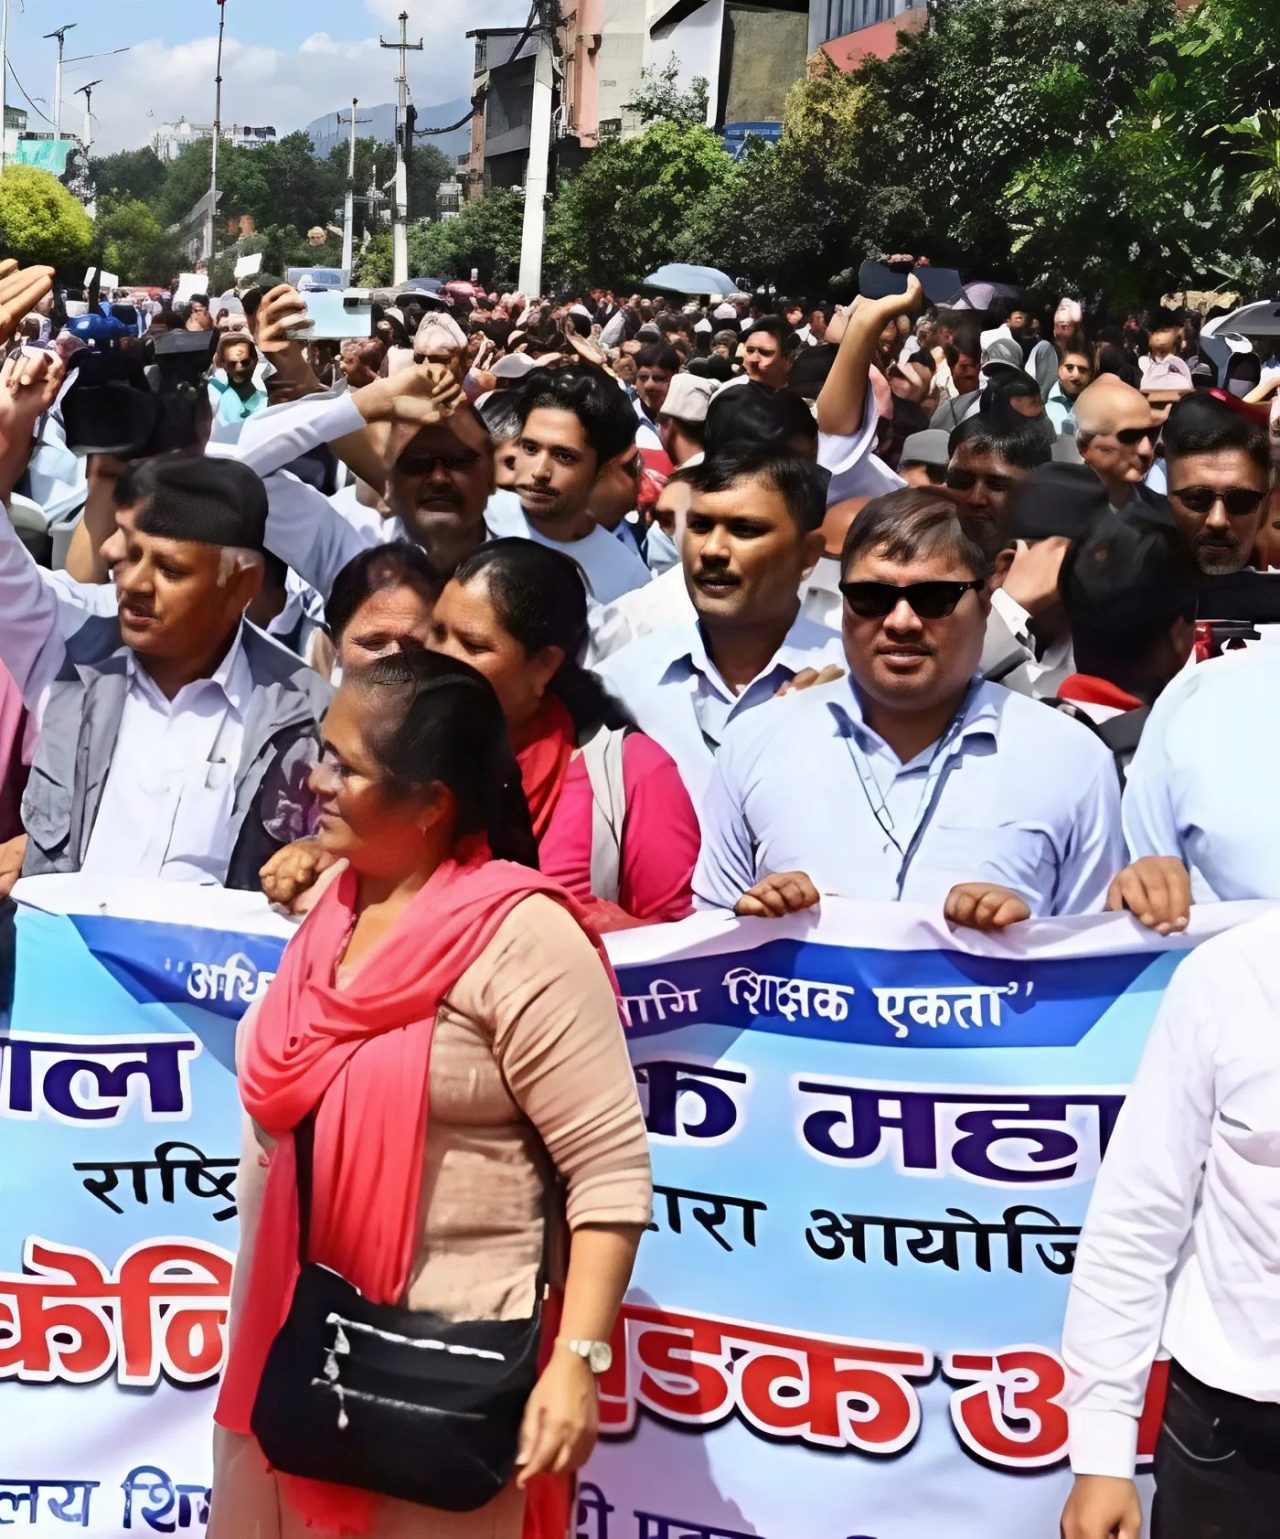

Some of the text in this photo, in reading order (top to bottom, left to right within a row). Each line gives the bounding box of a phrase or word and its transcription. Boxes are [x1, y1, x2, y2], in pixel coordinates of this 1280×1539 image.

[723, 967, 854, 1021] शिक्षक
[799, 1081, 1126, 1182] महा
[805, 1204, 1082, 1275] आयोजि
